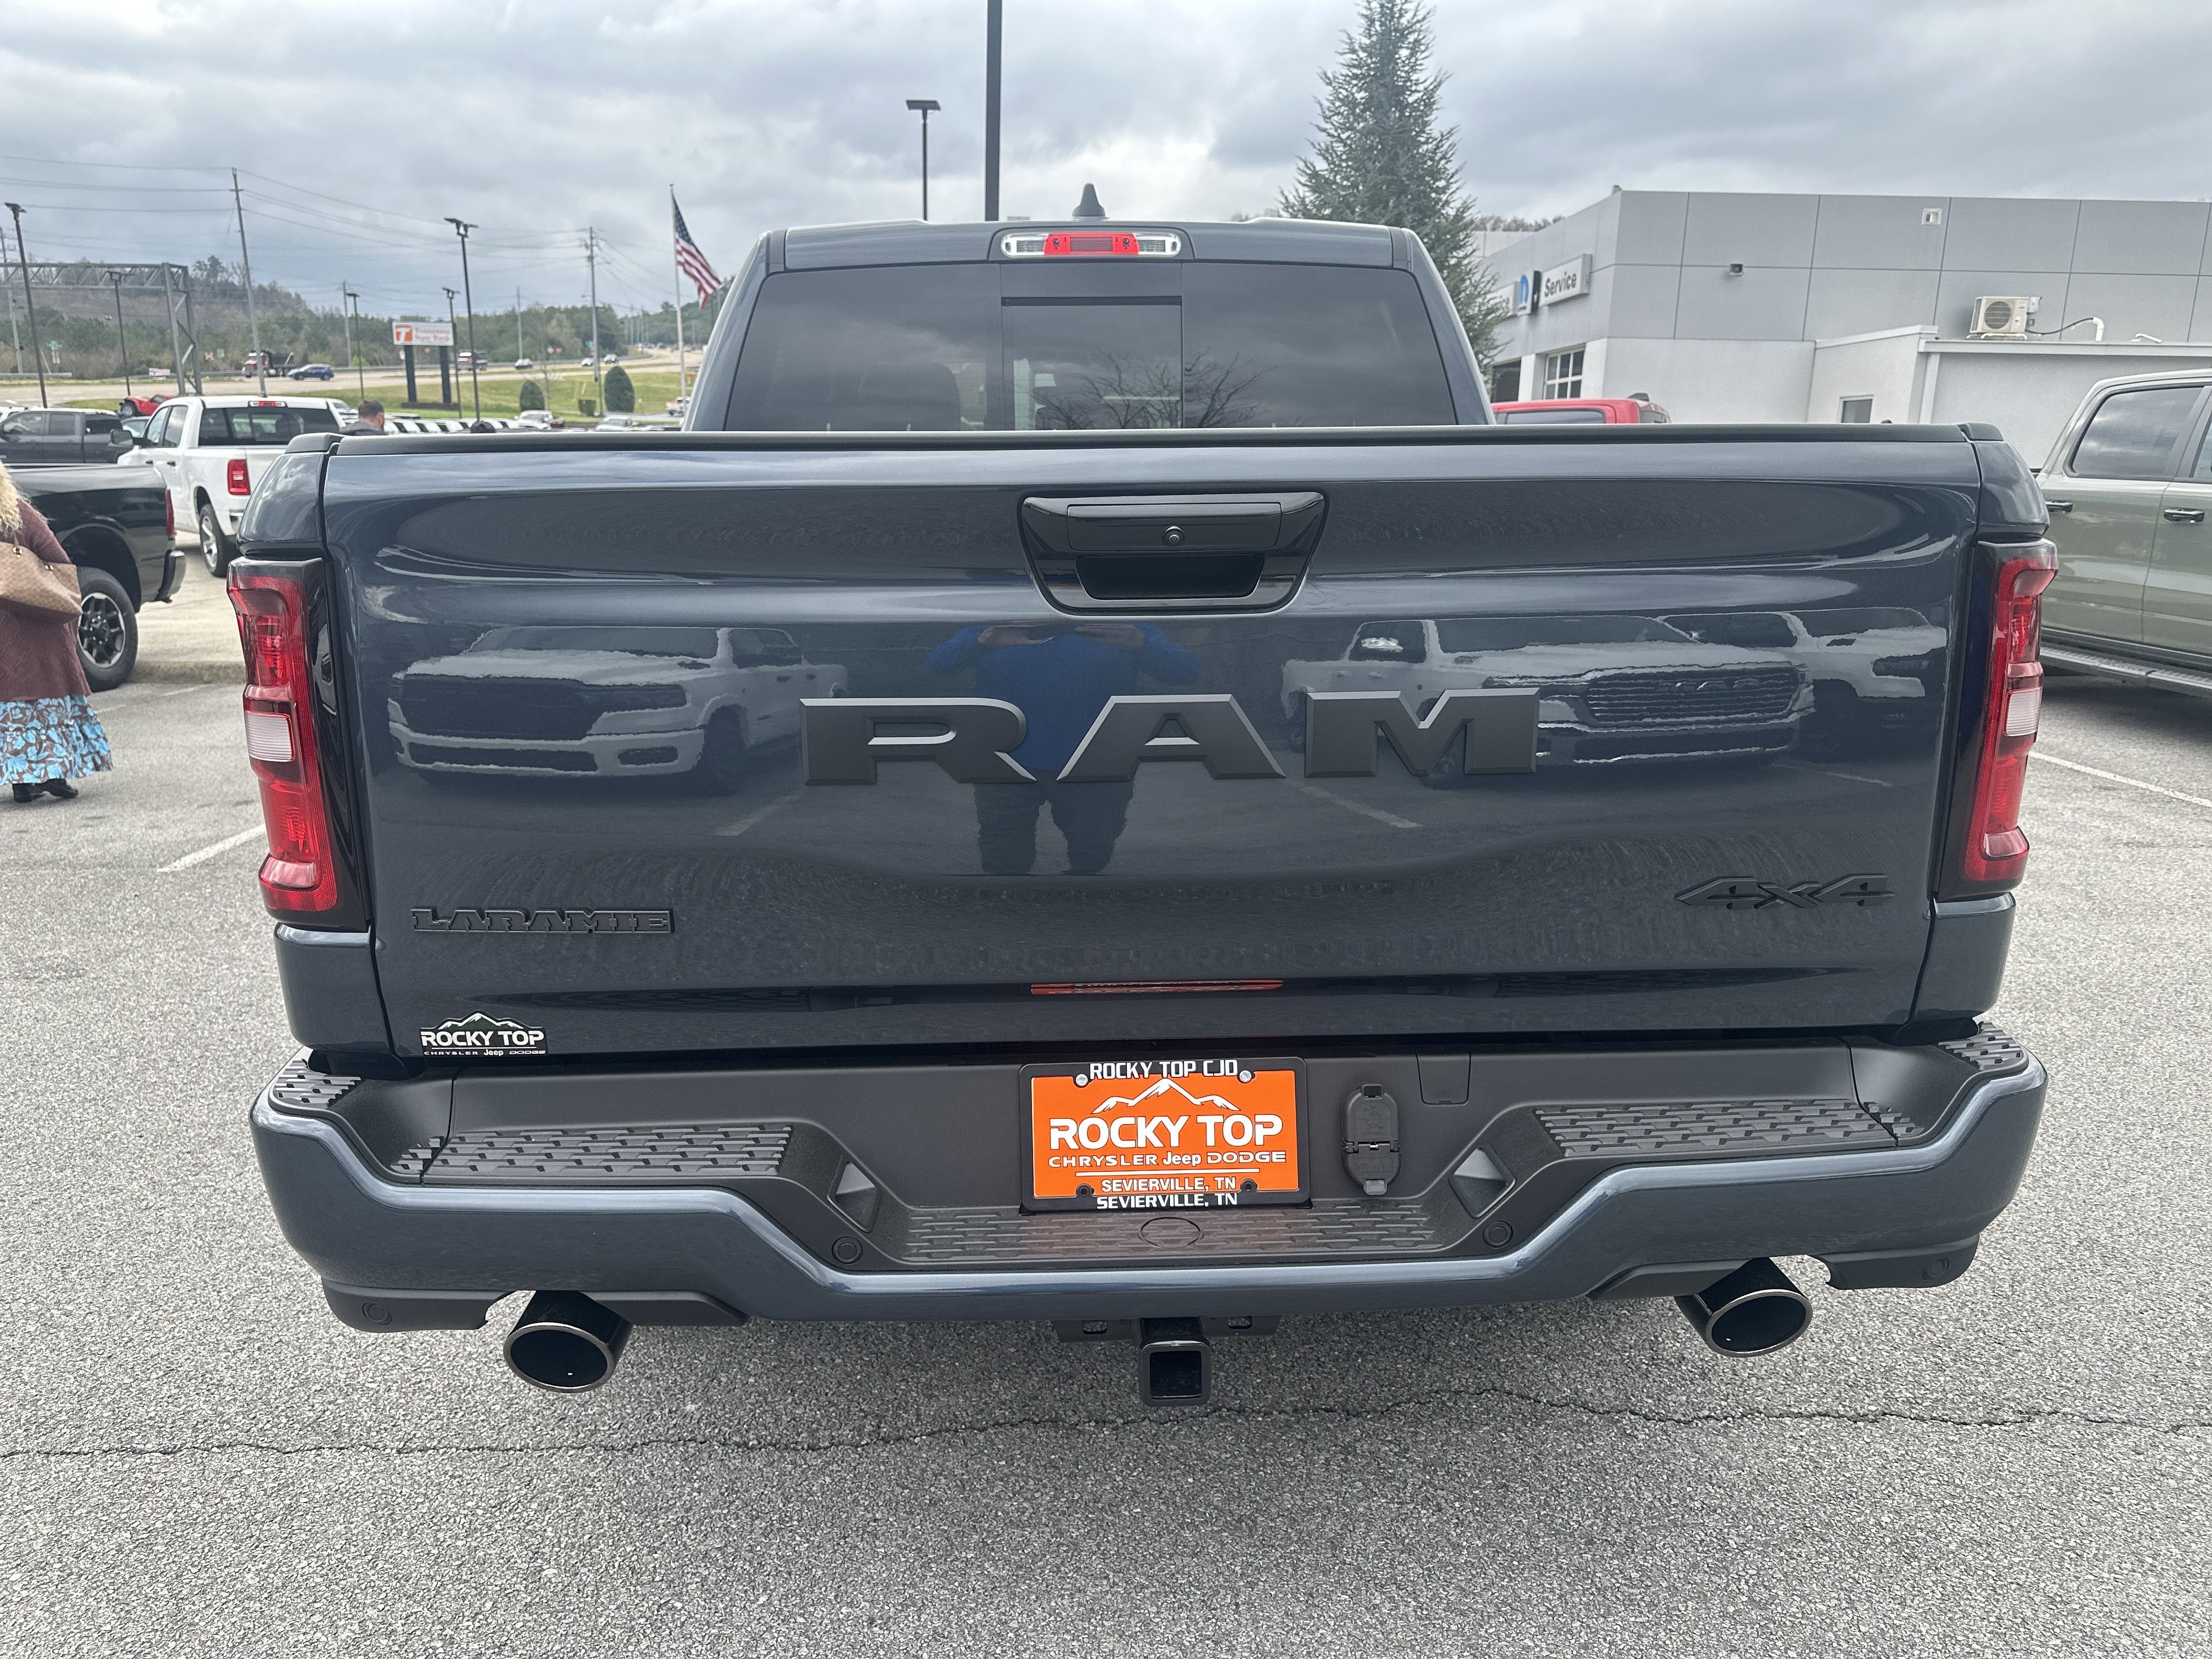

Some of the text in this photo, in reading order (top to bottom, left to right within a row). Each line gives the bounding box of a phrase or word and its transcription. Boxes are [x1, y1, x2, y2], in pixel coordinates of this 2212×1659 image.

[1544, 271, 1577, 297] Service
[800, 687, 1540, 785] RAM
[410, 909, 674, 933] LARAMIE
[420, 1030, 544, 1046] ROCKY TOP
[1090, 1059, 1238, 1080] ROCKY TOP CJD
[1049, 1114, 1283, 1150] ROCKY TOP
[1048, 1150, 1286, 1167] CHRYSLER Jeep DODGE
[1101, 1176, 1237, 1193] SEVIERVILLE, TN
[1097, 1193, 1238, 1209] SEVIERVILLE, TN
